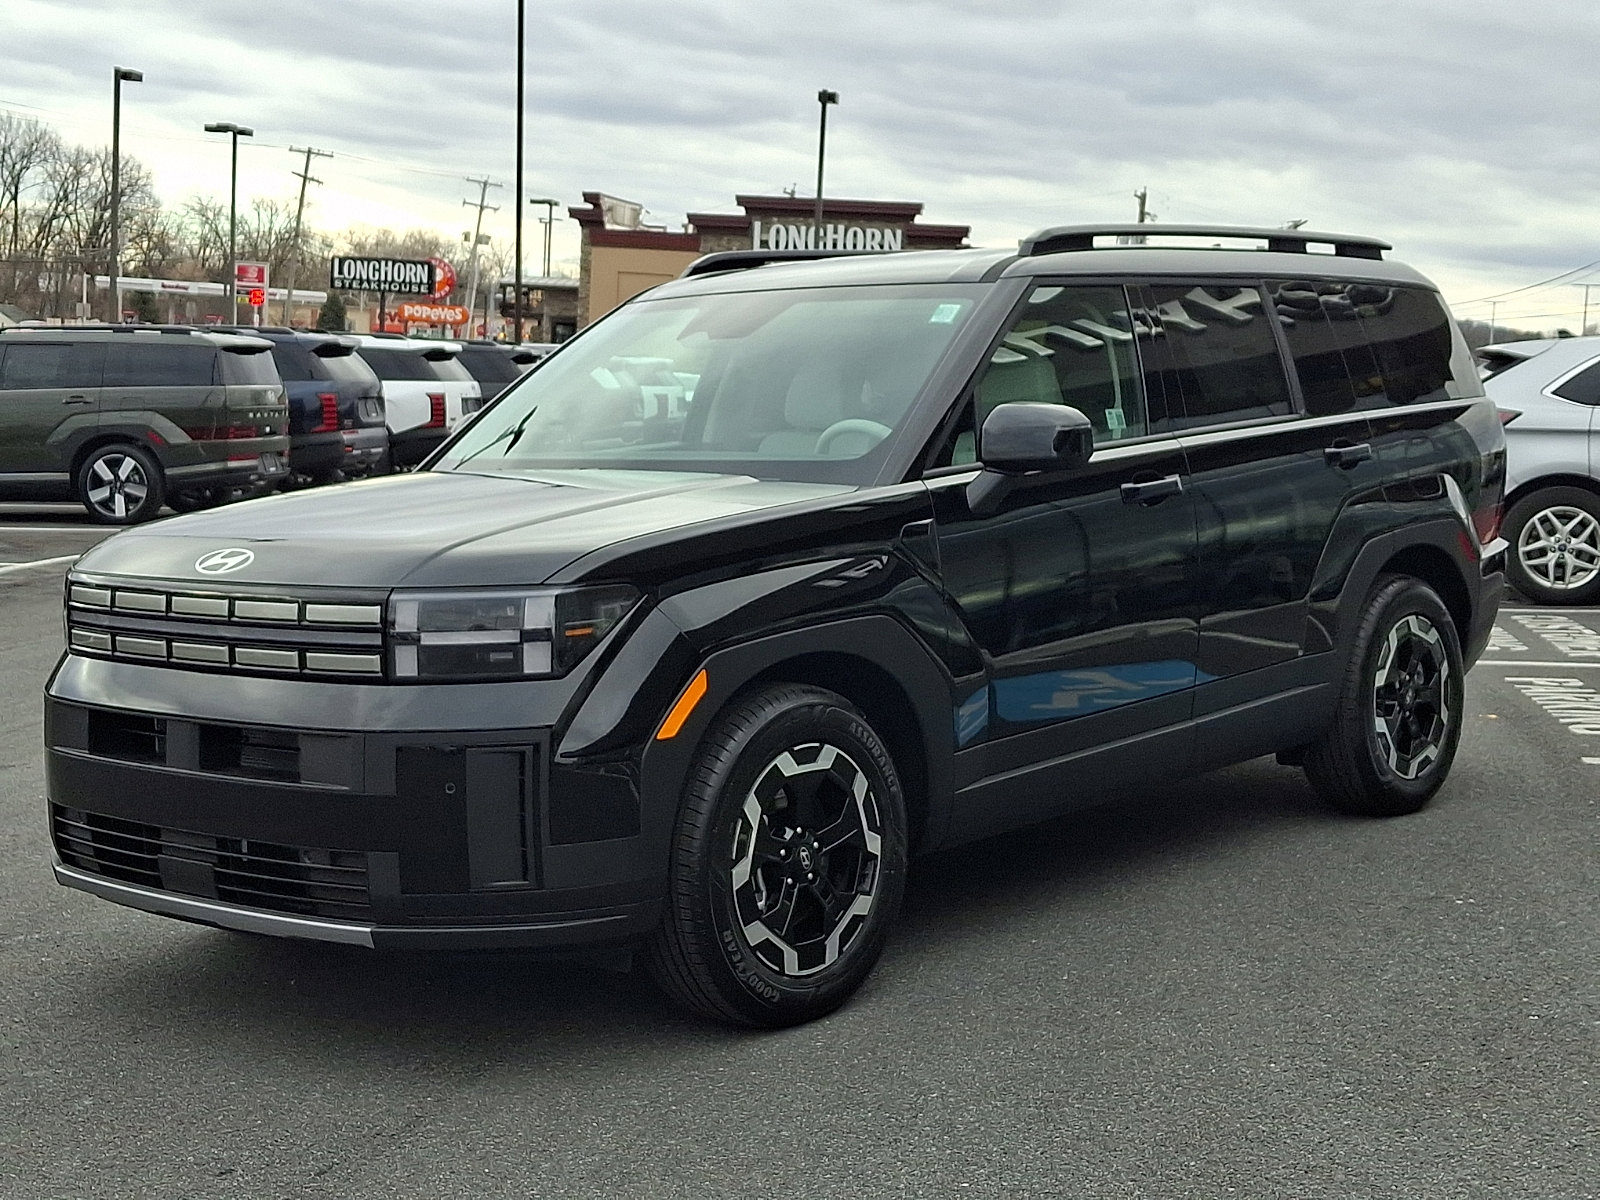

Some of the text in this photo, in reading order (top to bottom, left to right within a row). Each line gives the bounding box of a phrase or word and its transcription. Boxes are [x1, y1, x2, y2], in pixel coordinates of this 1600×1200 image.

[753, 221, 902, 251] LONGHORN
[333, 257, 429, 284] LONGHORN
[334, 280, 429, 293] STEAKHOUSE
[849, 721, 897, 792] ASSURANCE
